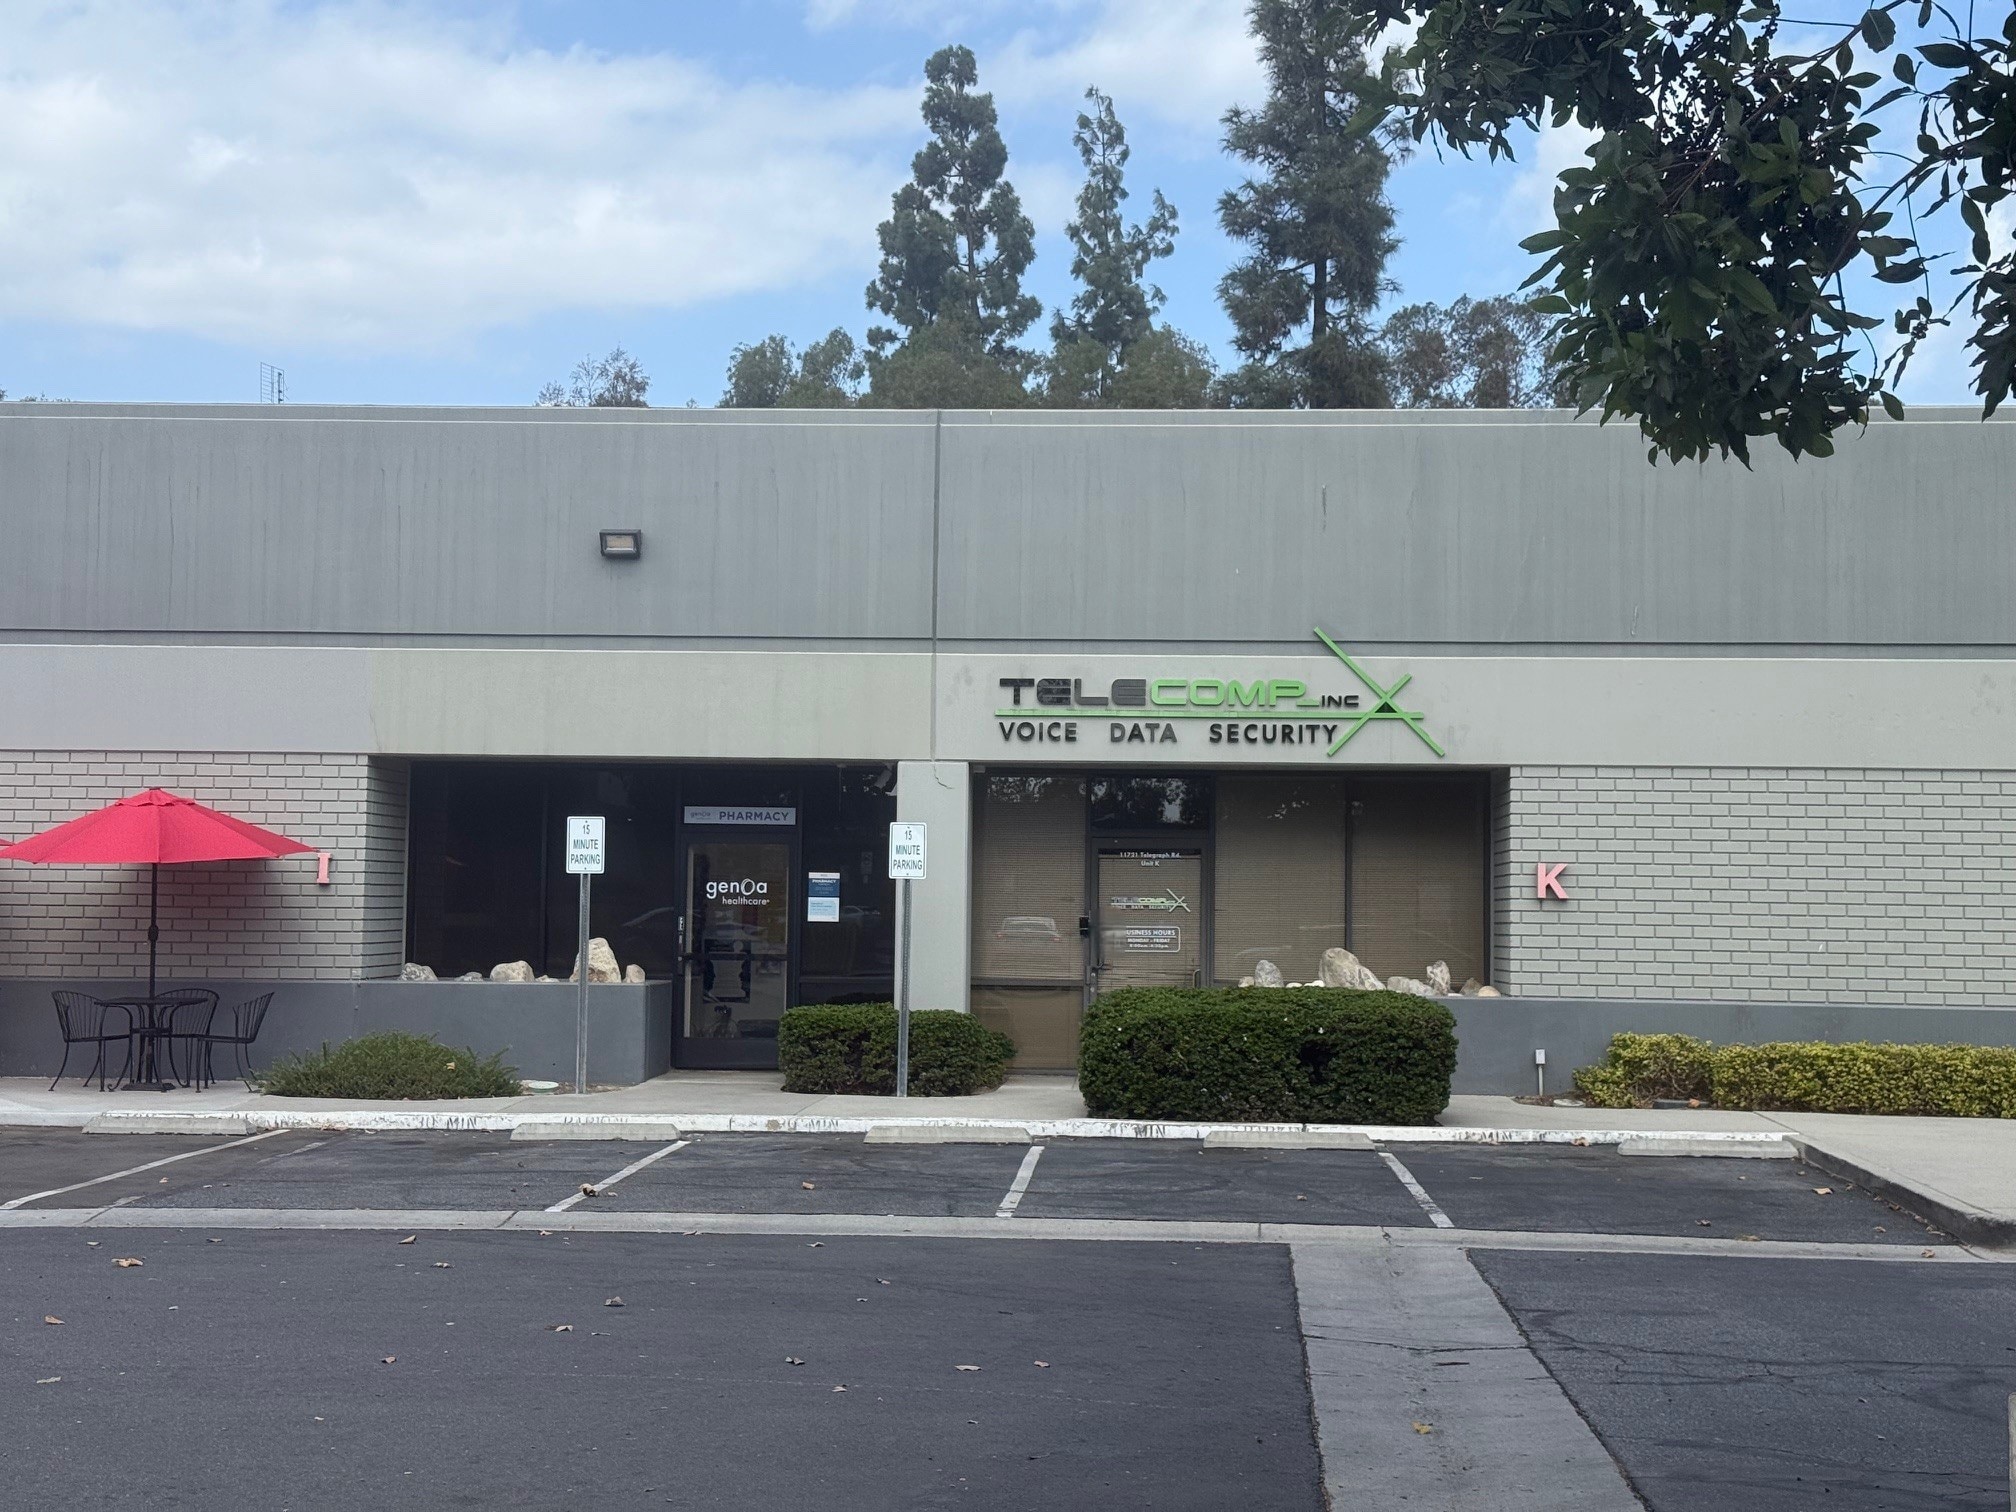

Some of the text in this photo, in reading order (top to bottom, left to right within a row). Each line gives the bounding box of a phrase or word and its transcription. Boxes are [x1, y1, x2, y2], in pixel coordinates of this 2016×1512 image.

[1321, 694, 1360, 708] INC
[999, 721, 1338, 744] VOICE DATA SECURITY
[719, 811, 789, 821] PHARMACY
[582, 824, 591, 835] 15
[904, 830, 913, 841] 15
[572, 839, 599, 850] MINUTE
[895, 844, 921, 856] MINUTE
[570, 853, 601, 865] PARKING
[1140, 851, 1170, 859] Telegraph
[316, 852, 332, 884] I
[892, 859, 923, 871] PARKING
[1537, 862, 1569, 900] K
